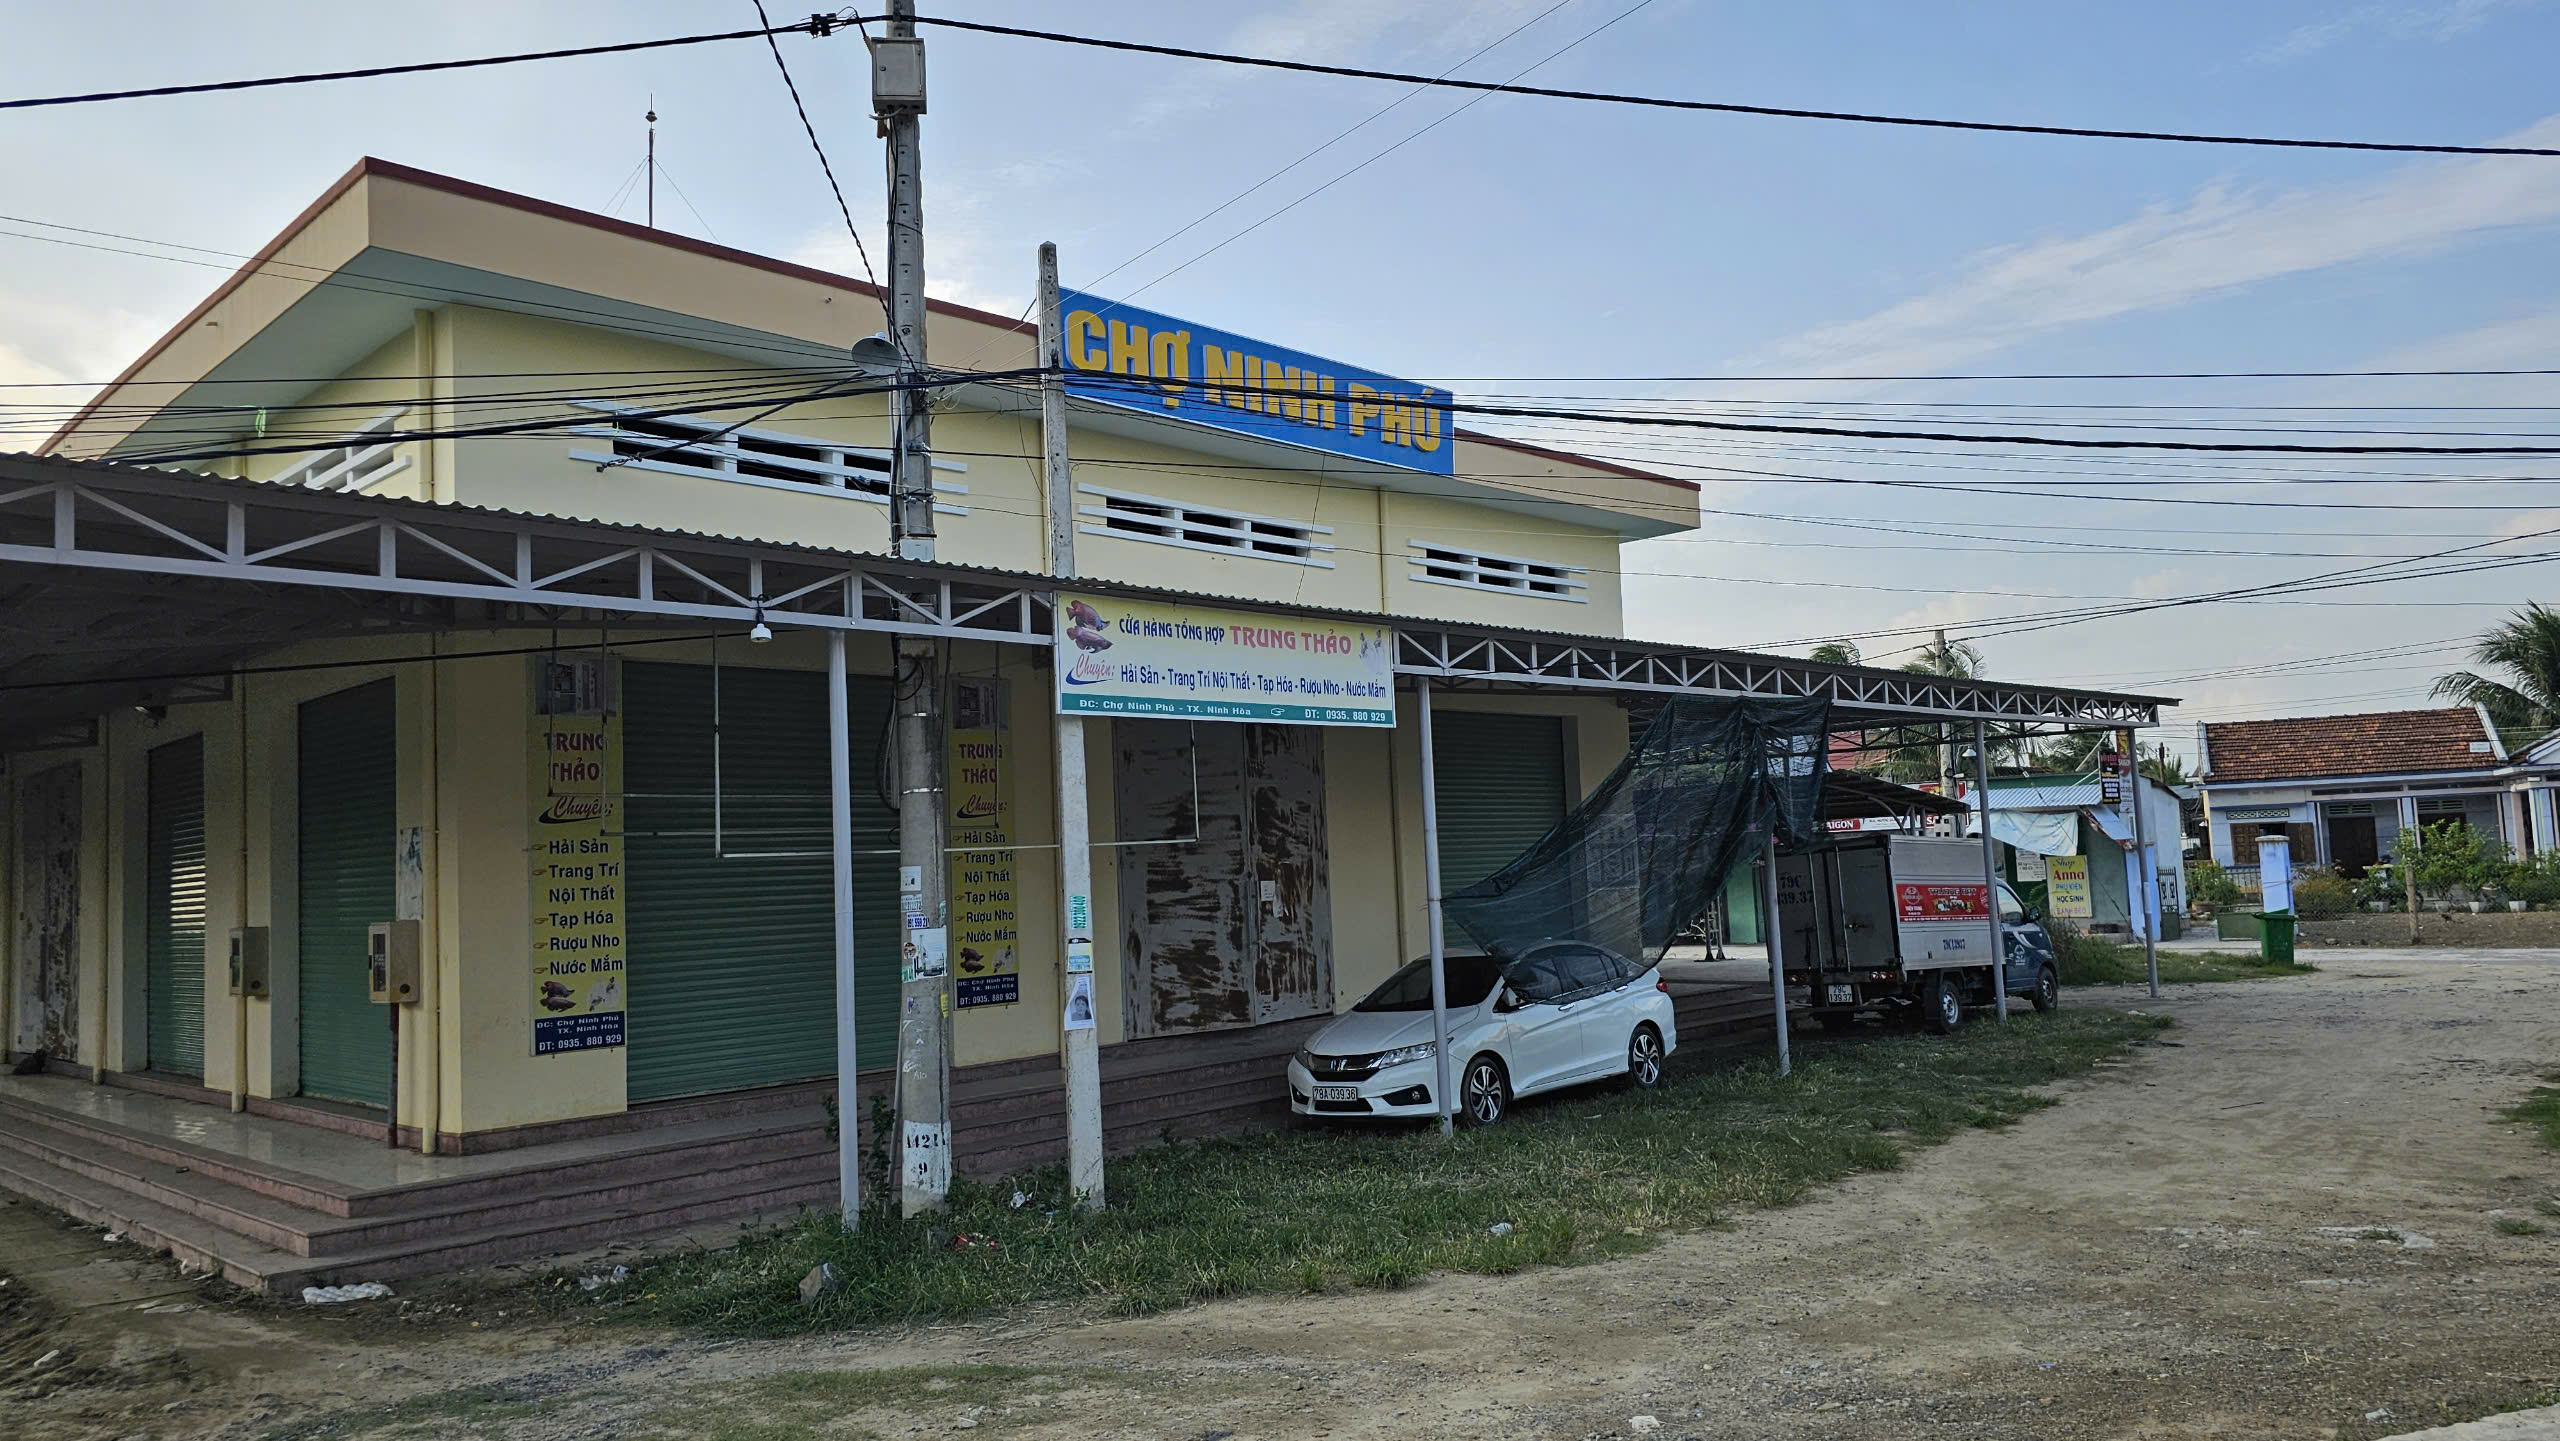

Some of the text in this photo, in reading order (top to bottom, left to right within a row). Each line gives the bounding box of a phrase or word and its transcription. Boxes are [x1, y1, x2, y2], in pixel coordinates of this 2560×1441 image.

[1064, 309, 1441, 452] CHỢ NINH PHÚ
[1119, 613, 1352, 655] CỬA HÀNG TỔNG HỢP TRUNG THẢO
[1076, 653, 1115, 681] Chuyên:
[1121, 663, 1137, 683] Hải
[1140, 664, 1159, 685] Sản
[1167, 668, 1195, 691] Trang
[1197, 669, 1210, 688] Trí
[1212, 670, 1228, 692] Nội
[1230, 670, 1251, 690] Thất
[1257, 674, 1274, 696] Tạp
[1276, 675, 1293, 693] Hóa
[1300, 677, 1322, 698] Rượu
[1323, 679, 1340, 696] Nho
[1346, 679, 1366, 697] Nước
[1368, 678, 1386, 698] Mắm
[1079, 699, 1098, 708] ĐC:
[1103, 700, 1123, 710] Chợ
[1127, 702, 1151, 711] Ninh
[1155, 703, 1175, 712] Phú
[1186, 705, 1203, 713] TX.
[1207, 705, 1229, 714] Ninh
[1232, 707, 1251, 715] Hòa
[1305, 709, 1320, 719] ĐT:
[1326, 710, 1349, 720] 0935.
[1352, 711, 1368, 721] 880
[1370, 712, 1386, 722] 929
[1826, 820, 1854, 829] AIGON
[964, 829, 1006, 843] Hải Sản
[549, 837, 609, 854] Hải Sản
[964, 850, 1013, 865] Trang Trí
[548, 862, 619, 880] Trang Trí
[965, 868, 1010, 885] Nội Thất
[2053, 869, 2084, 880] Anna
[549, 884, 615, 904] Nội Thất
[964, 889, 1010, 905] Tạp Hóa
[2056, 895, 2084, 903] HỌC SINH
[548, 910, 614, 929] Tạp Hóa
[966, 908, 1014, 924] Rượu Nho
[550, 934, 620, 952] Rượu Nho
[966, 926, 1017, 943] Nước Mắm
[550, 954, 623, 975] Nước Mắm
[992, 993, 1004, 1002] 880
[1005, 992, 1017, 1000] 929
[1833, 985, 1846, 993] 79C
[578, 1017, 599, 1025] Ninh
[558, 1038, 583, 1049] 0935.
[586, 1036, 602, 1046] 880
[605, 1034, 622, 1044] 929
